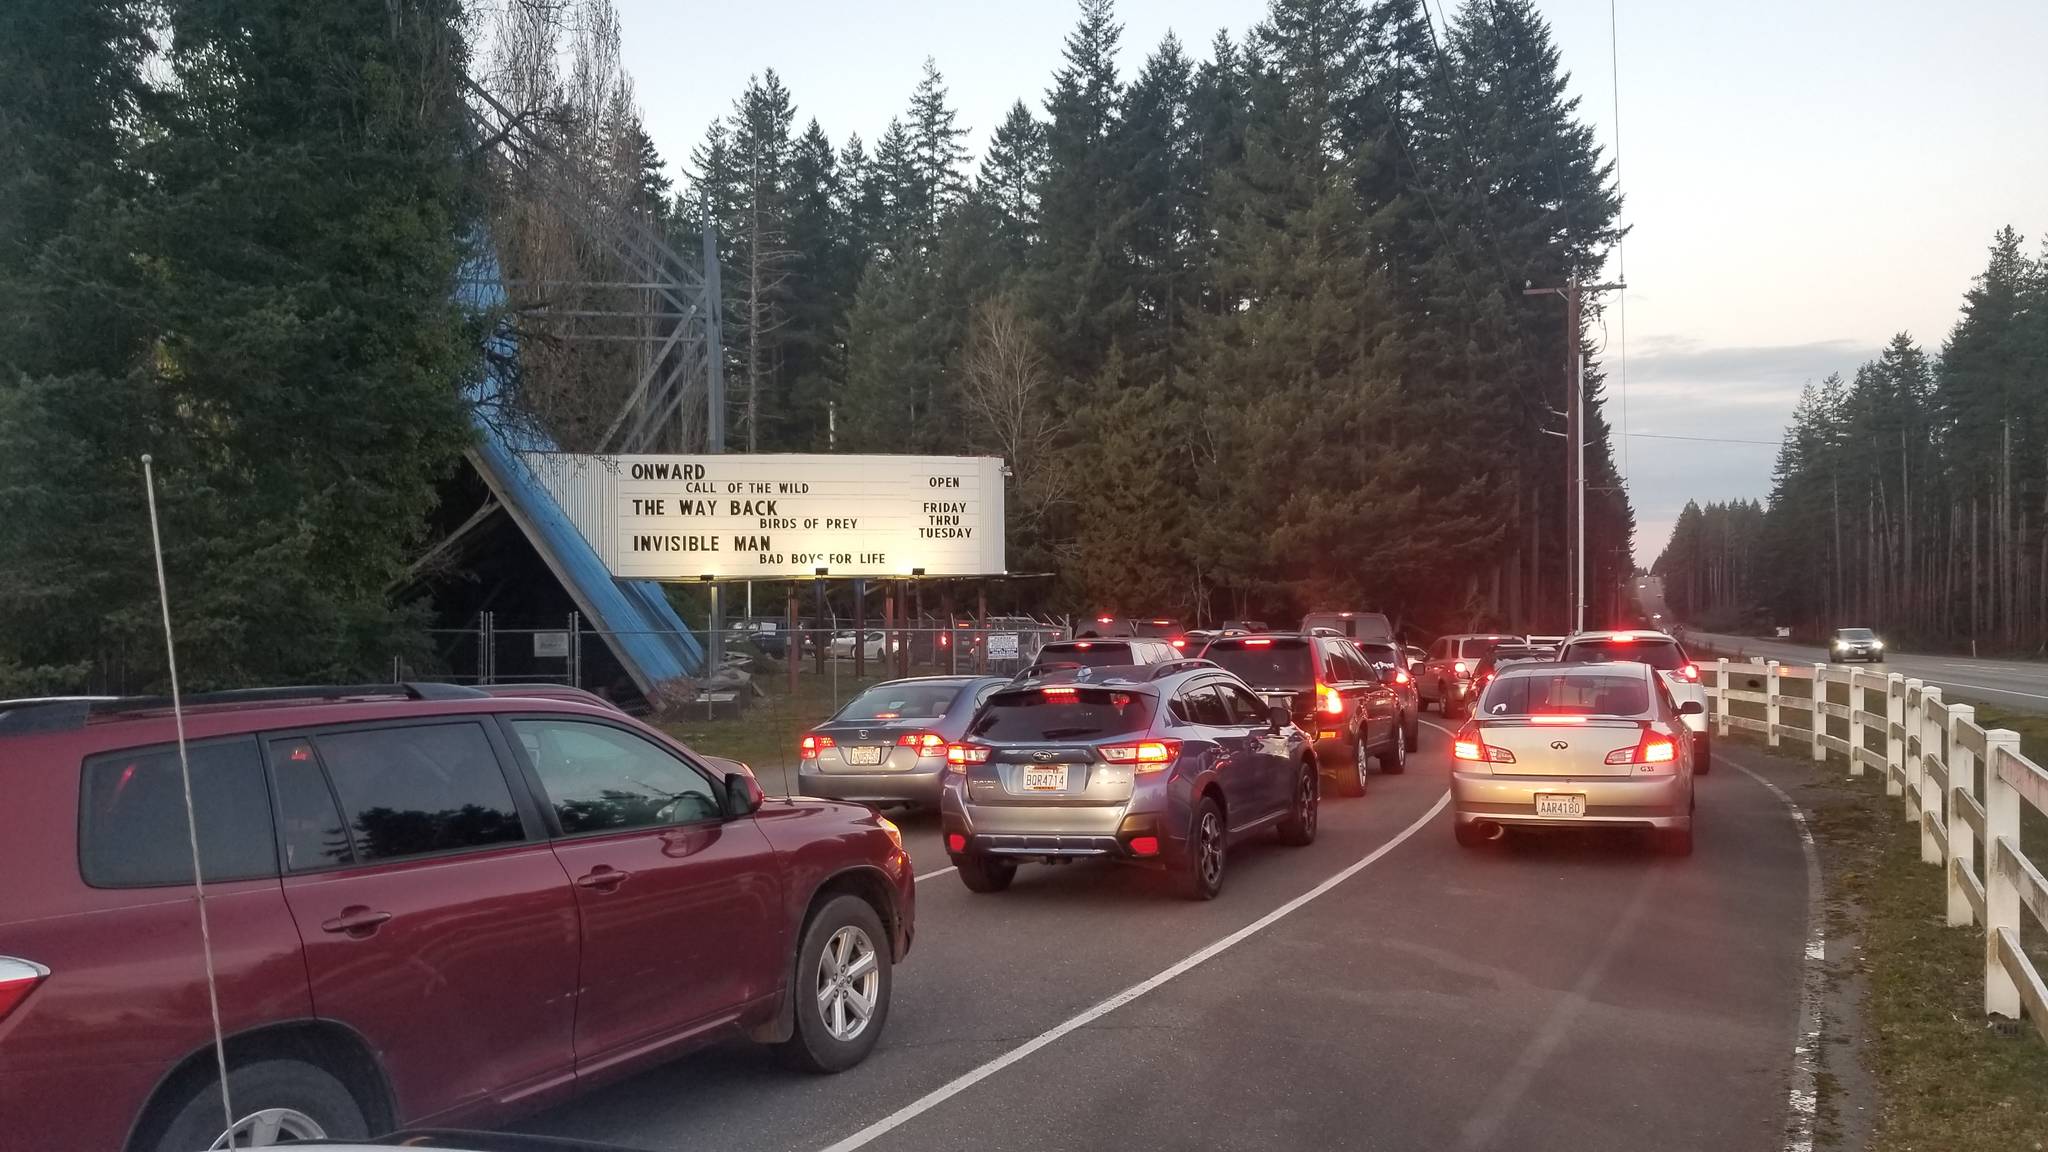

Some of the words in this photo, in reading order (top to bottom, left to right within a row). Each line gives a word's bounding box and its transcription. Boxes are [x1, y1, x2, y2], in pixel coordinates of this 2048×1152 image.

[631, 463, 706, 480] ONWARD
[686, 482, 717, 493] CALL
[728, 483, 743, 494] OF
[749, 483, 772, 494] THE
[779, 483, 809, 494] WILD
[929, 477, 960, 488] OPEN
[632, 499, 665, 516] THE
[679, 500, 717, 516] WAY
[730, 500, 778, 516] BACK
[923, 502, 967, 513] FRIDAY
[759, 518, 797, 529] BIRDS
[804, 518, 819, 529] OF
[826, 518, 858, 529] PREY
[928, 515, 960, 526] THRU
[918, 527, 972, 538] TUESDAY
[633, 535, 719, 552] INVISIBLE
[734, 536, 771, 552] MAN
[759, 553, 784, 564] BAD
[791, 553, 824, 564] BOYS
[829, 553, 852, 564] FOR
[860, 553, 886, 564] LIFE
[1541, 802, 1580, 813] AAR4180
